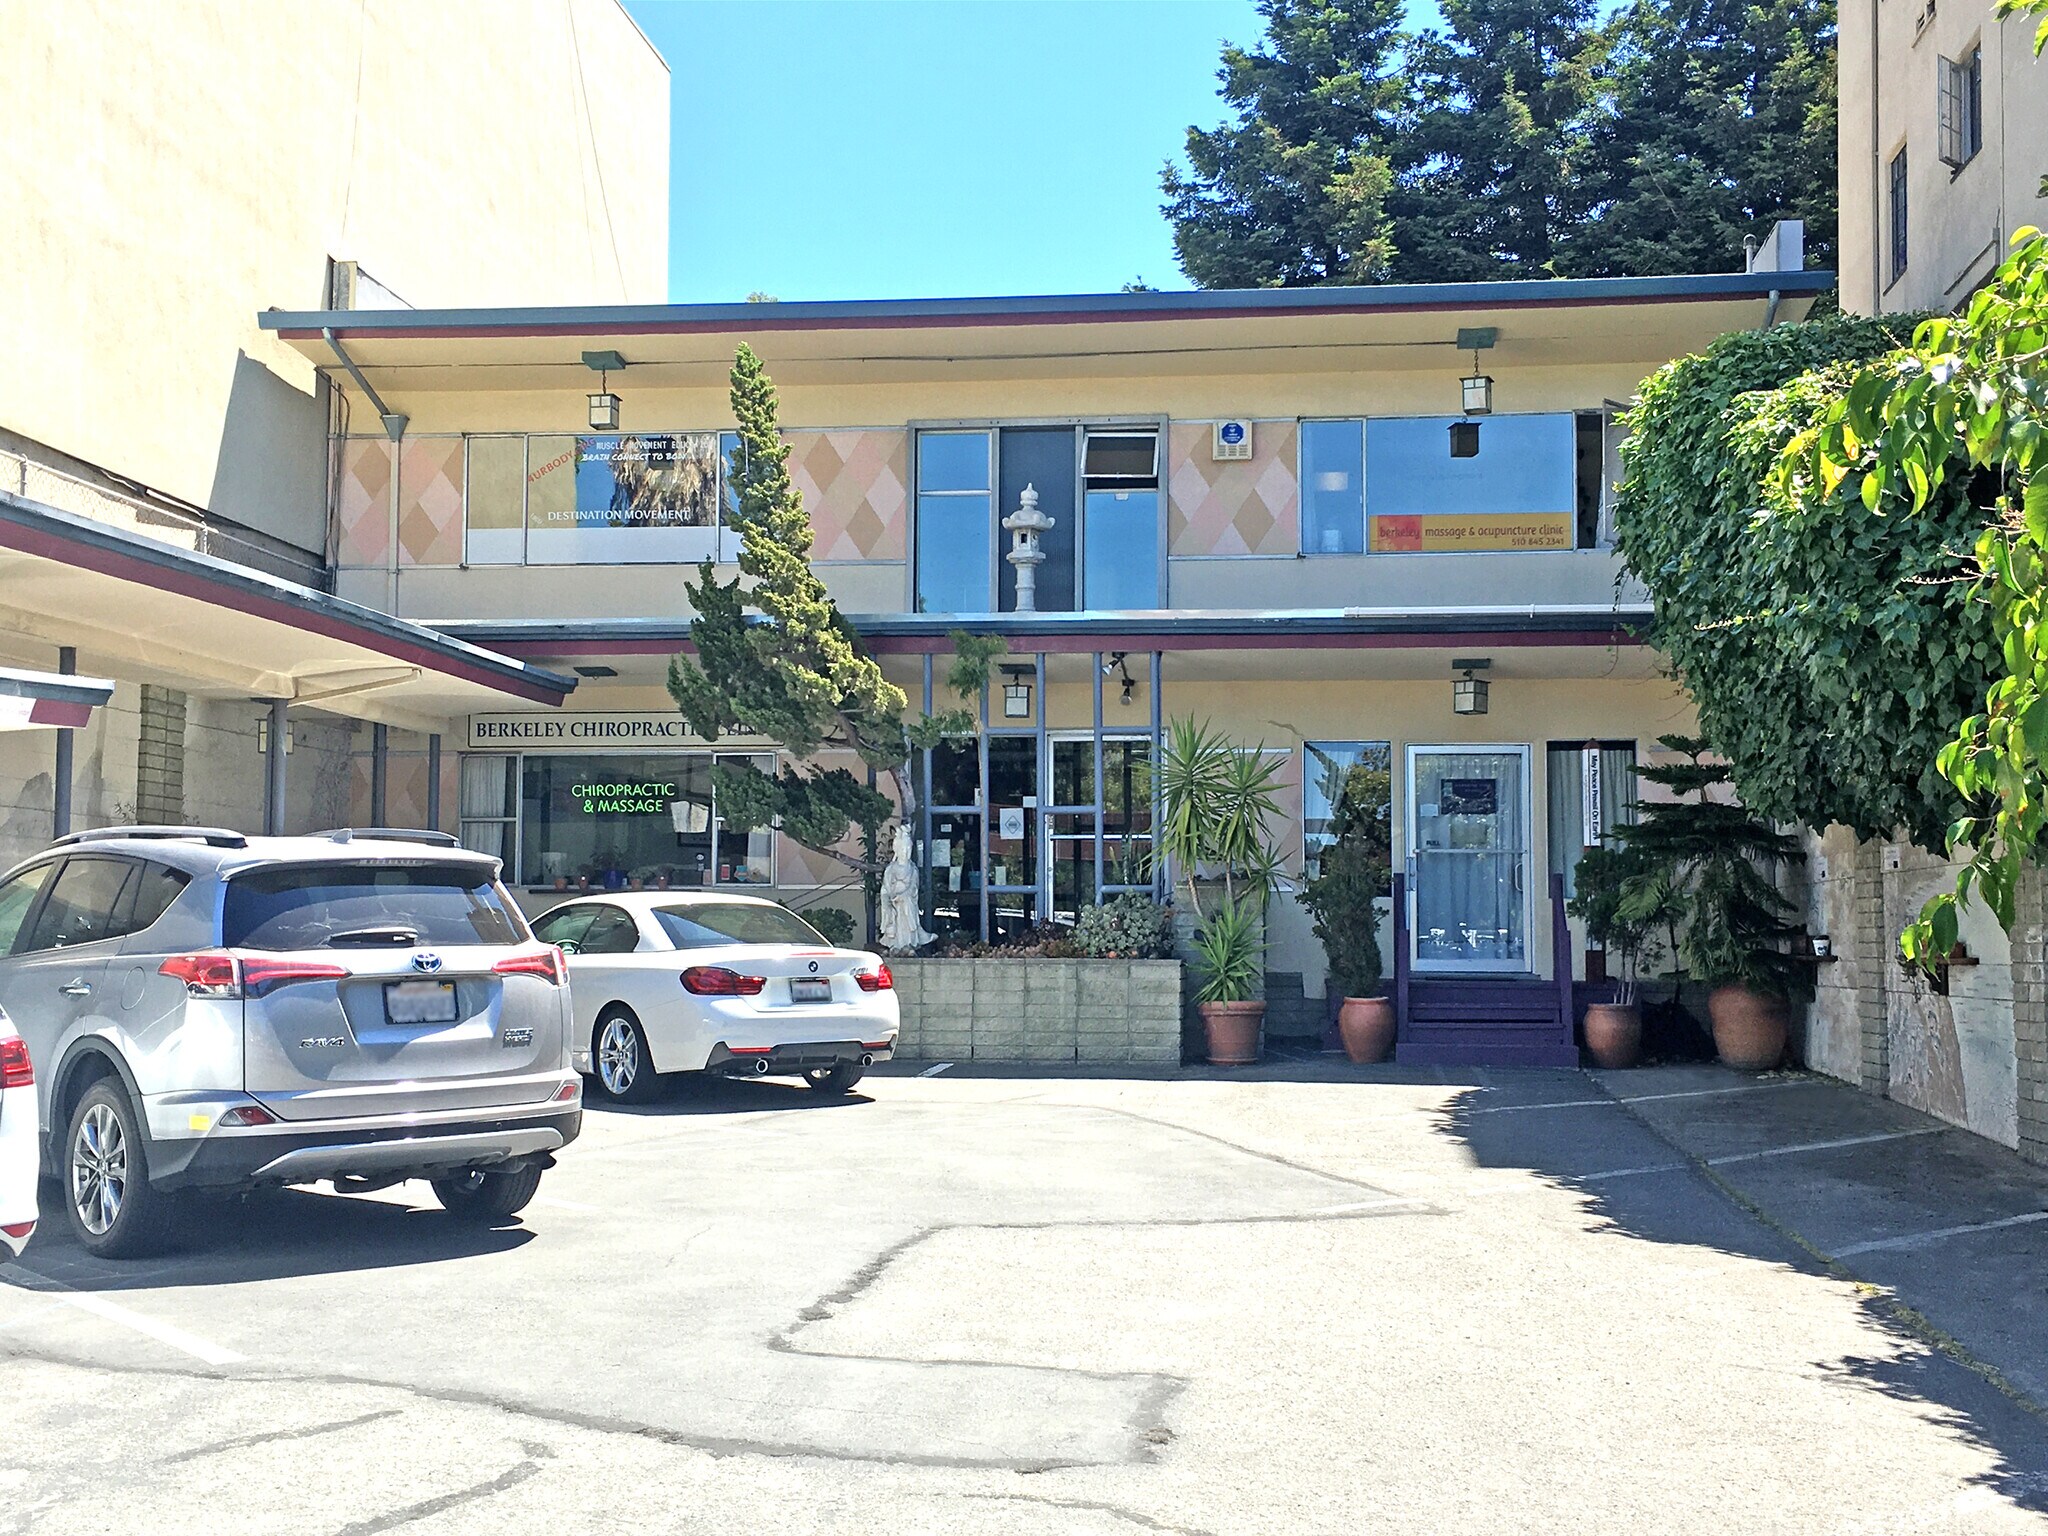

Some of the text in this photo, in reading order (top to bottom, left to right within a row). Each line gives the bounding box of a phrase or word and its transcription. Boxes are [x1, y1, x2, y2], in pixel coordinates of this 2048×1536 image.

[597, 441, 625, 449] MUSCLE
[582, 453, 610, 462] BRAIN
[611, 453, 651, 462] CONNECT
[651, 453, 664, 461] TO
[548, 510, 622, 521] DESTINATION
[624, 509, 690, 521] MOVEMENT
[1379, 524, 1564, 540] berkeley massage & acupuncture clinic
[1511, 537, 1564, 546] 510 845 2341
[476, 722, 567, 738] BERKELEY
[570, 721, 696, 737] CHIROPRACTI
[571, 782, 676, 799] CHIROPRACTIC
[583, 799, 664, 813] & MASSAGE
[1592, 811, 1599, 821] On
[298, 1036, 345, 1049] RAV4
